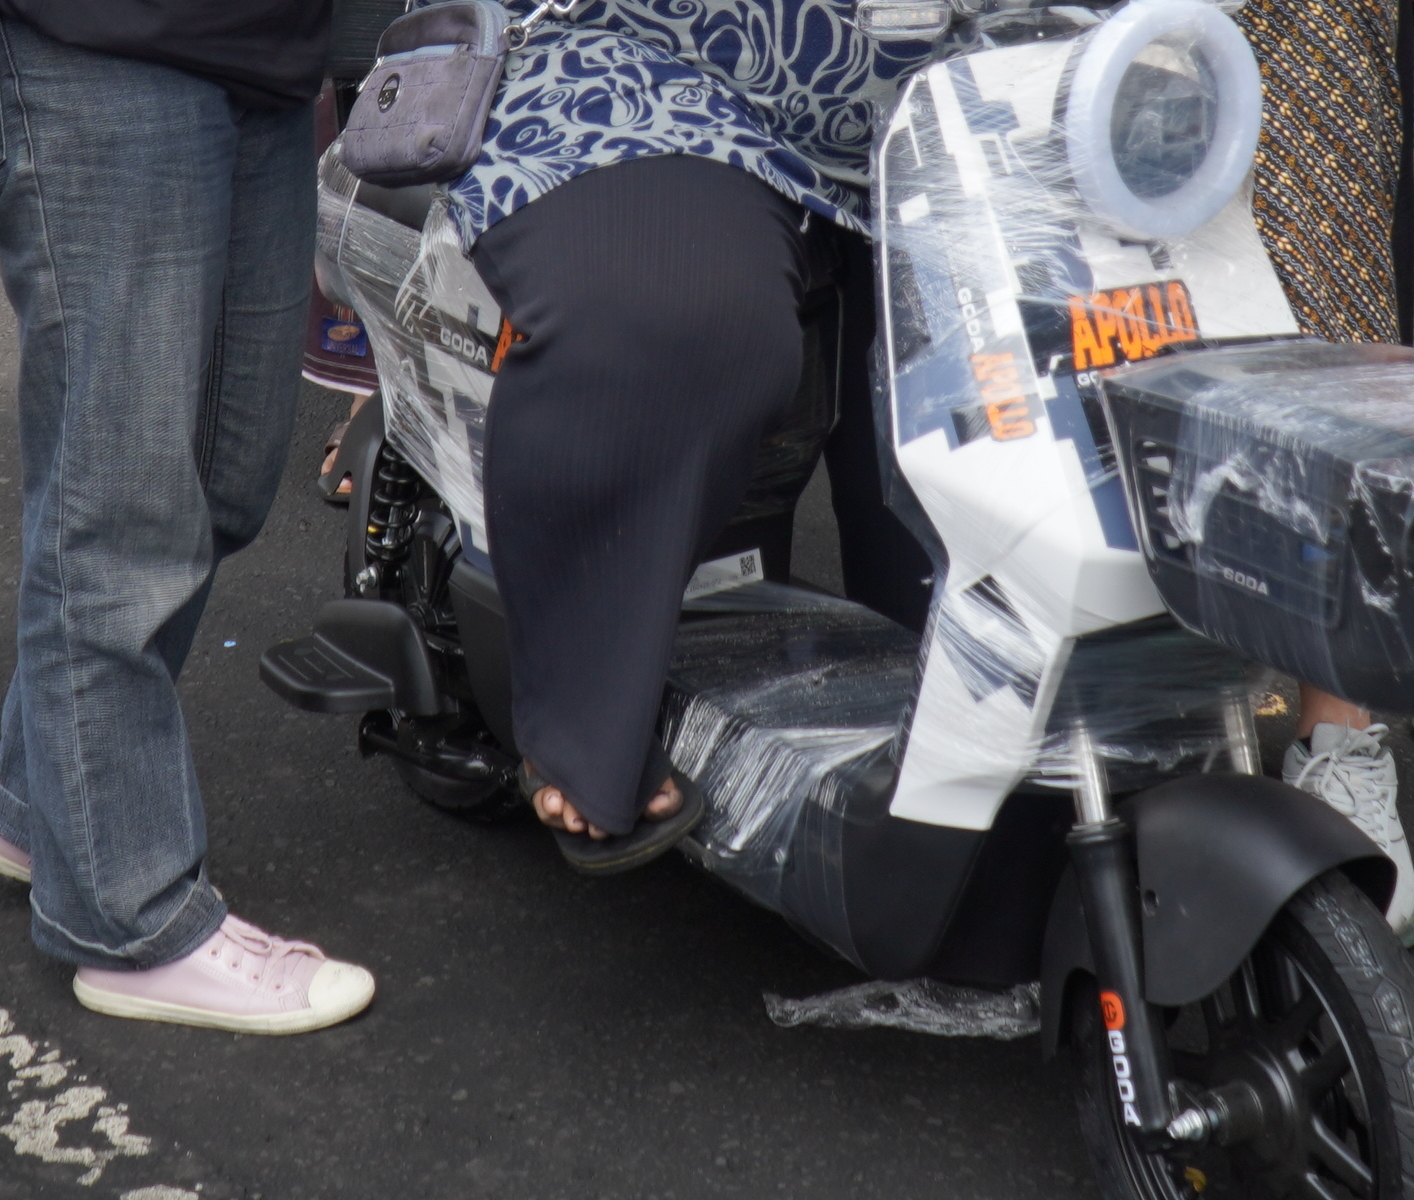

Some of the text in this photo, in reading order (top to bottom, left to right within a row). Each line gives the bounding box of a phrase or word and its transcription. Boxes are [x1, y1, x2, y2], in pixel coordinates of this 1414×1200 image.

[440, 327, 488, 365] GODA
[958, 287, 985, 353] GODA
[1068, 279, 1198, 371] APOLLO
[1077, 370, 1099, 387] GO
[1223, 567, 1269, 596] GODA
[1108, 1030, 1141, 1126] GODA
